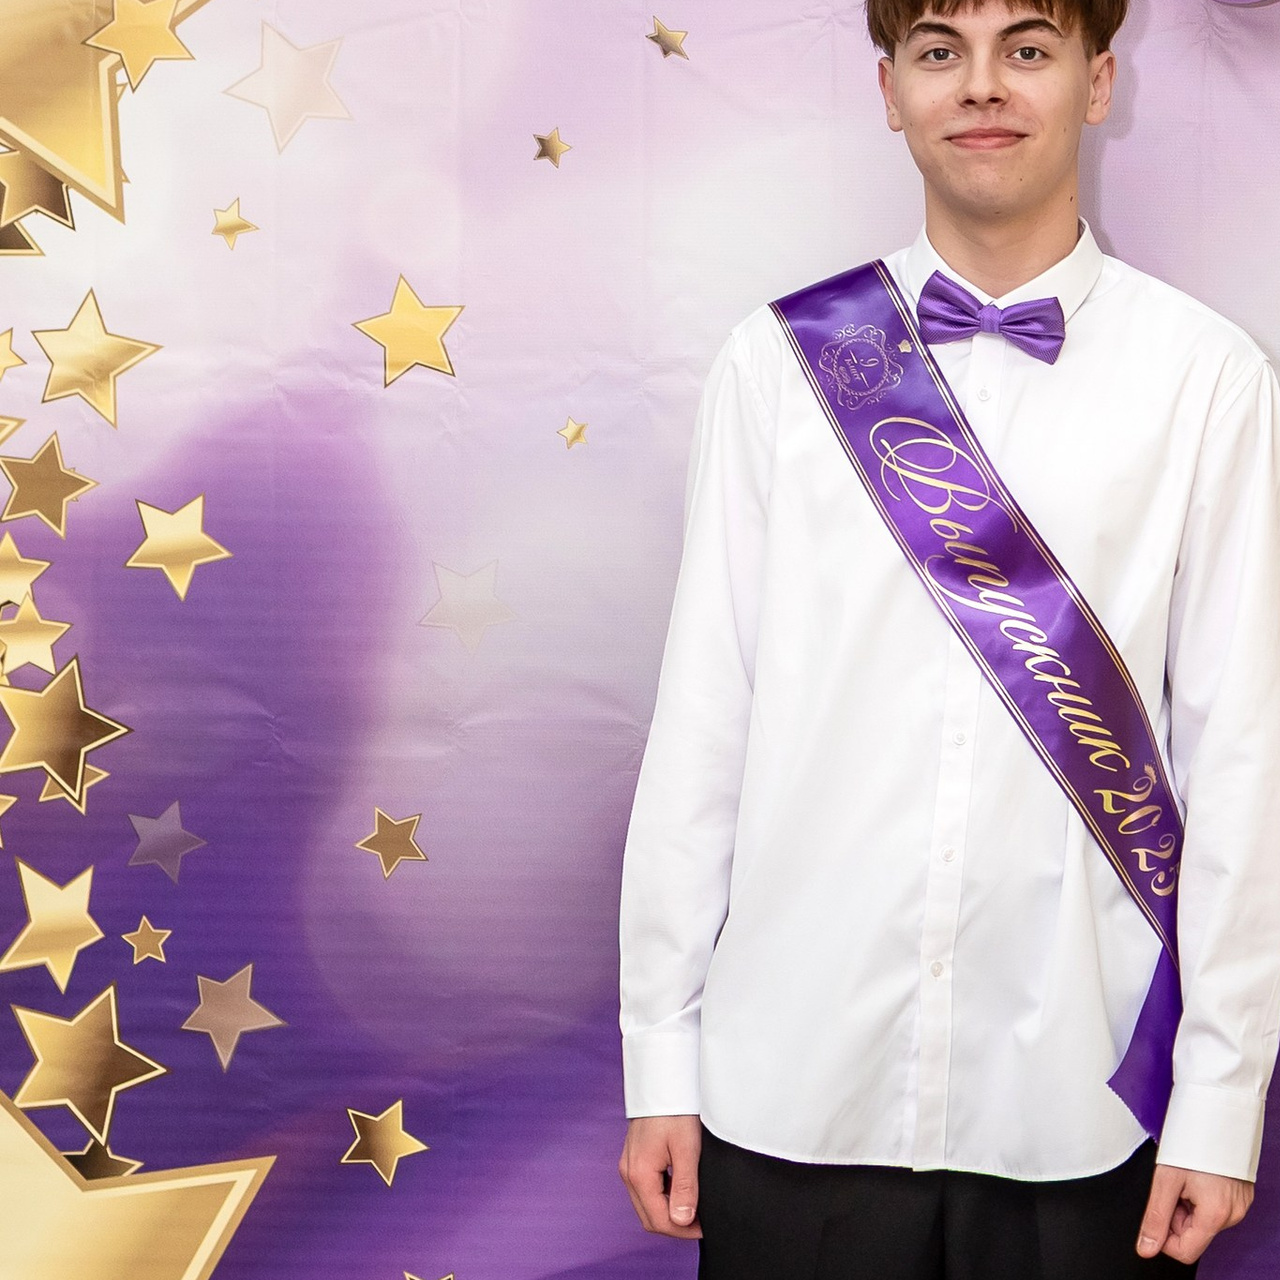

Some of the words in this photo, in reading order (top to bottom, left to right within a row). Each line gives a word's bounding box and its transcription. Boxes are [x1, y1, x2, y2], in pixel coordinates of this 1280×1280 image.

[859, 357, 879, 367] 9
[869, 417, 1130, 772] Выпускник
[1093, 776, 1180, 897] 2025
